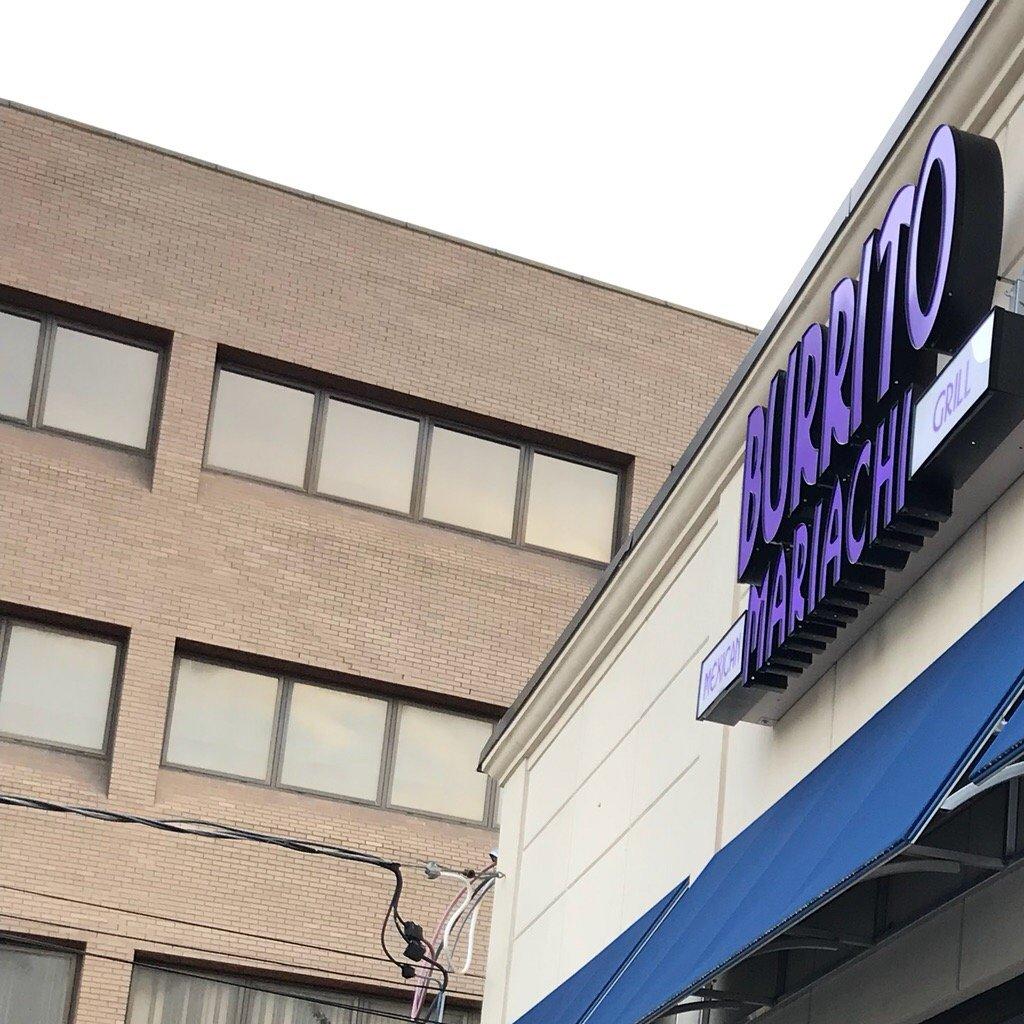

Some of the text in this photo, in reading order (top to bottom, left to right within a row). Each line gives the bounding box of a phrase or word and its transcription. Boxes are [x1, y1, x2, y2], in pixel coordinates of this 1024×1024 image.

[738, 124, 957, 584] BURRITO
[933, 360, 971, 431] GRILL
[743, 389, 914, 687] MARIACHI
[703, 637, 740, 700] MEXICAN
